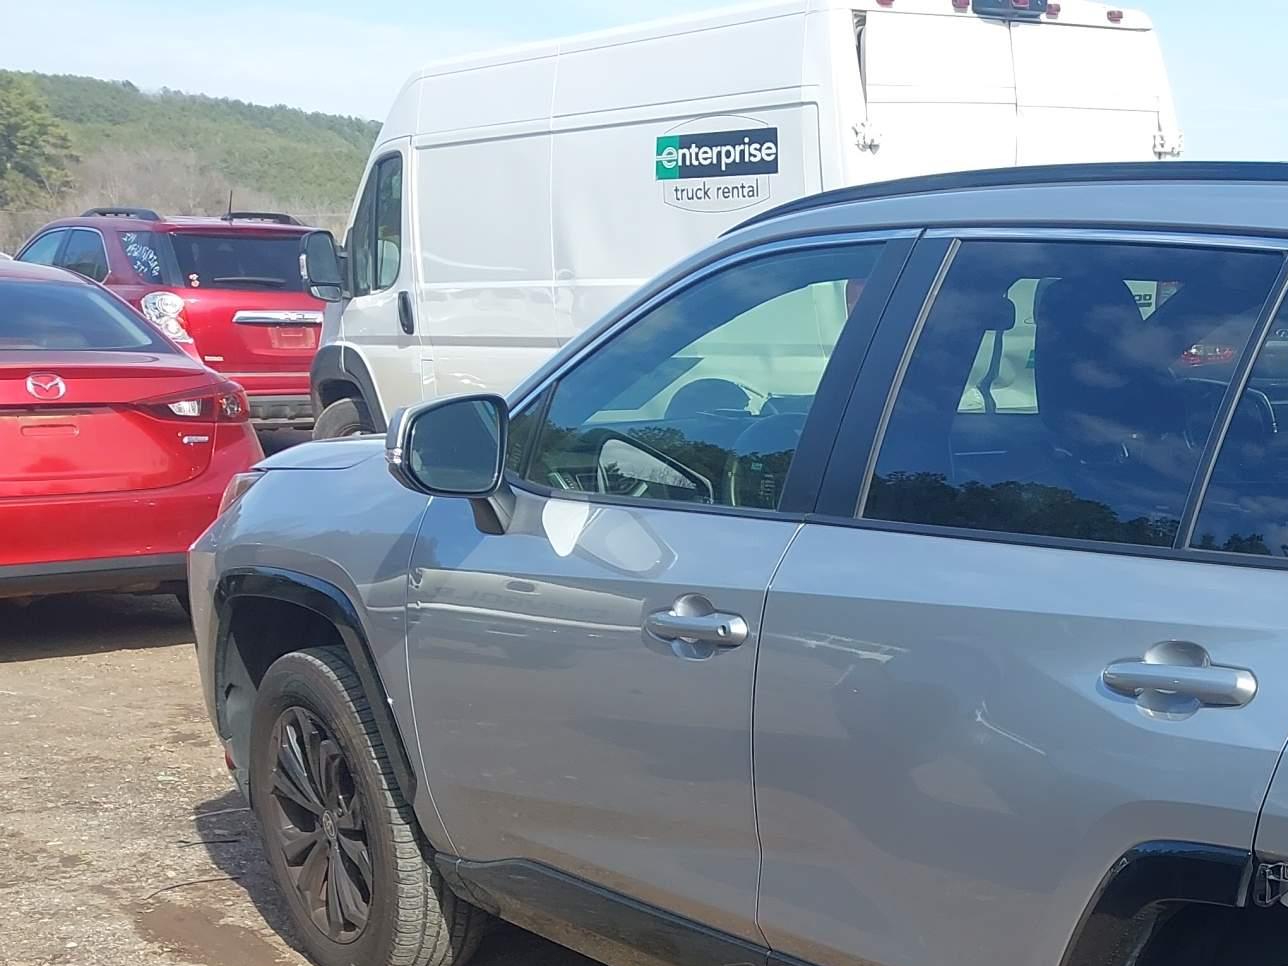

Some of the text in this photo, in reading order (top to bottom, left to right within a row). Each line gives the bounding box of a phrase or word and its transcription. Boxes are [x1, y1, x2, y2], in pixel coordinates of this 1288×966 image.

[656, 136, 777, 171] enterprise
[674, 178, 759, 201] truck rental
